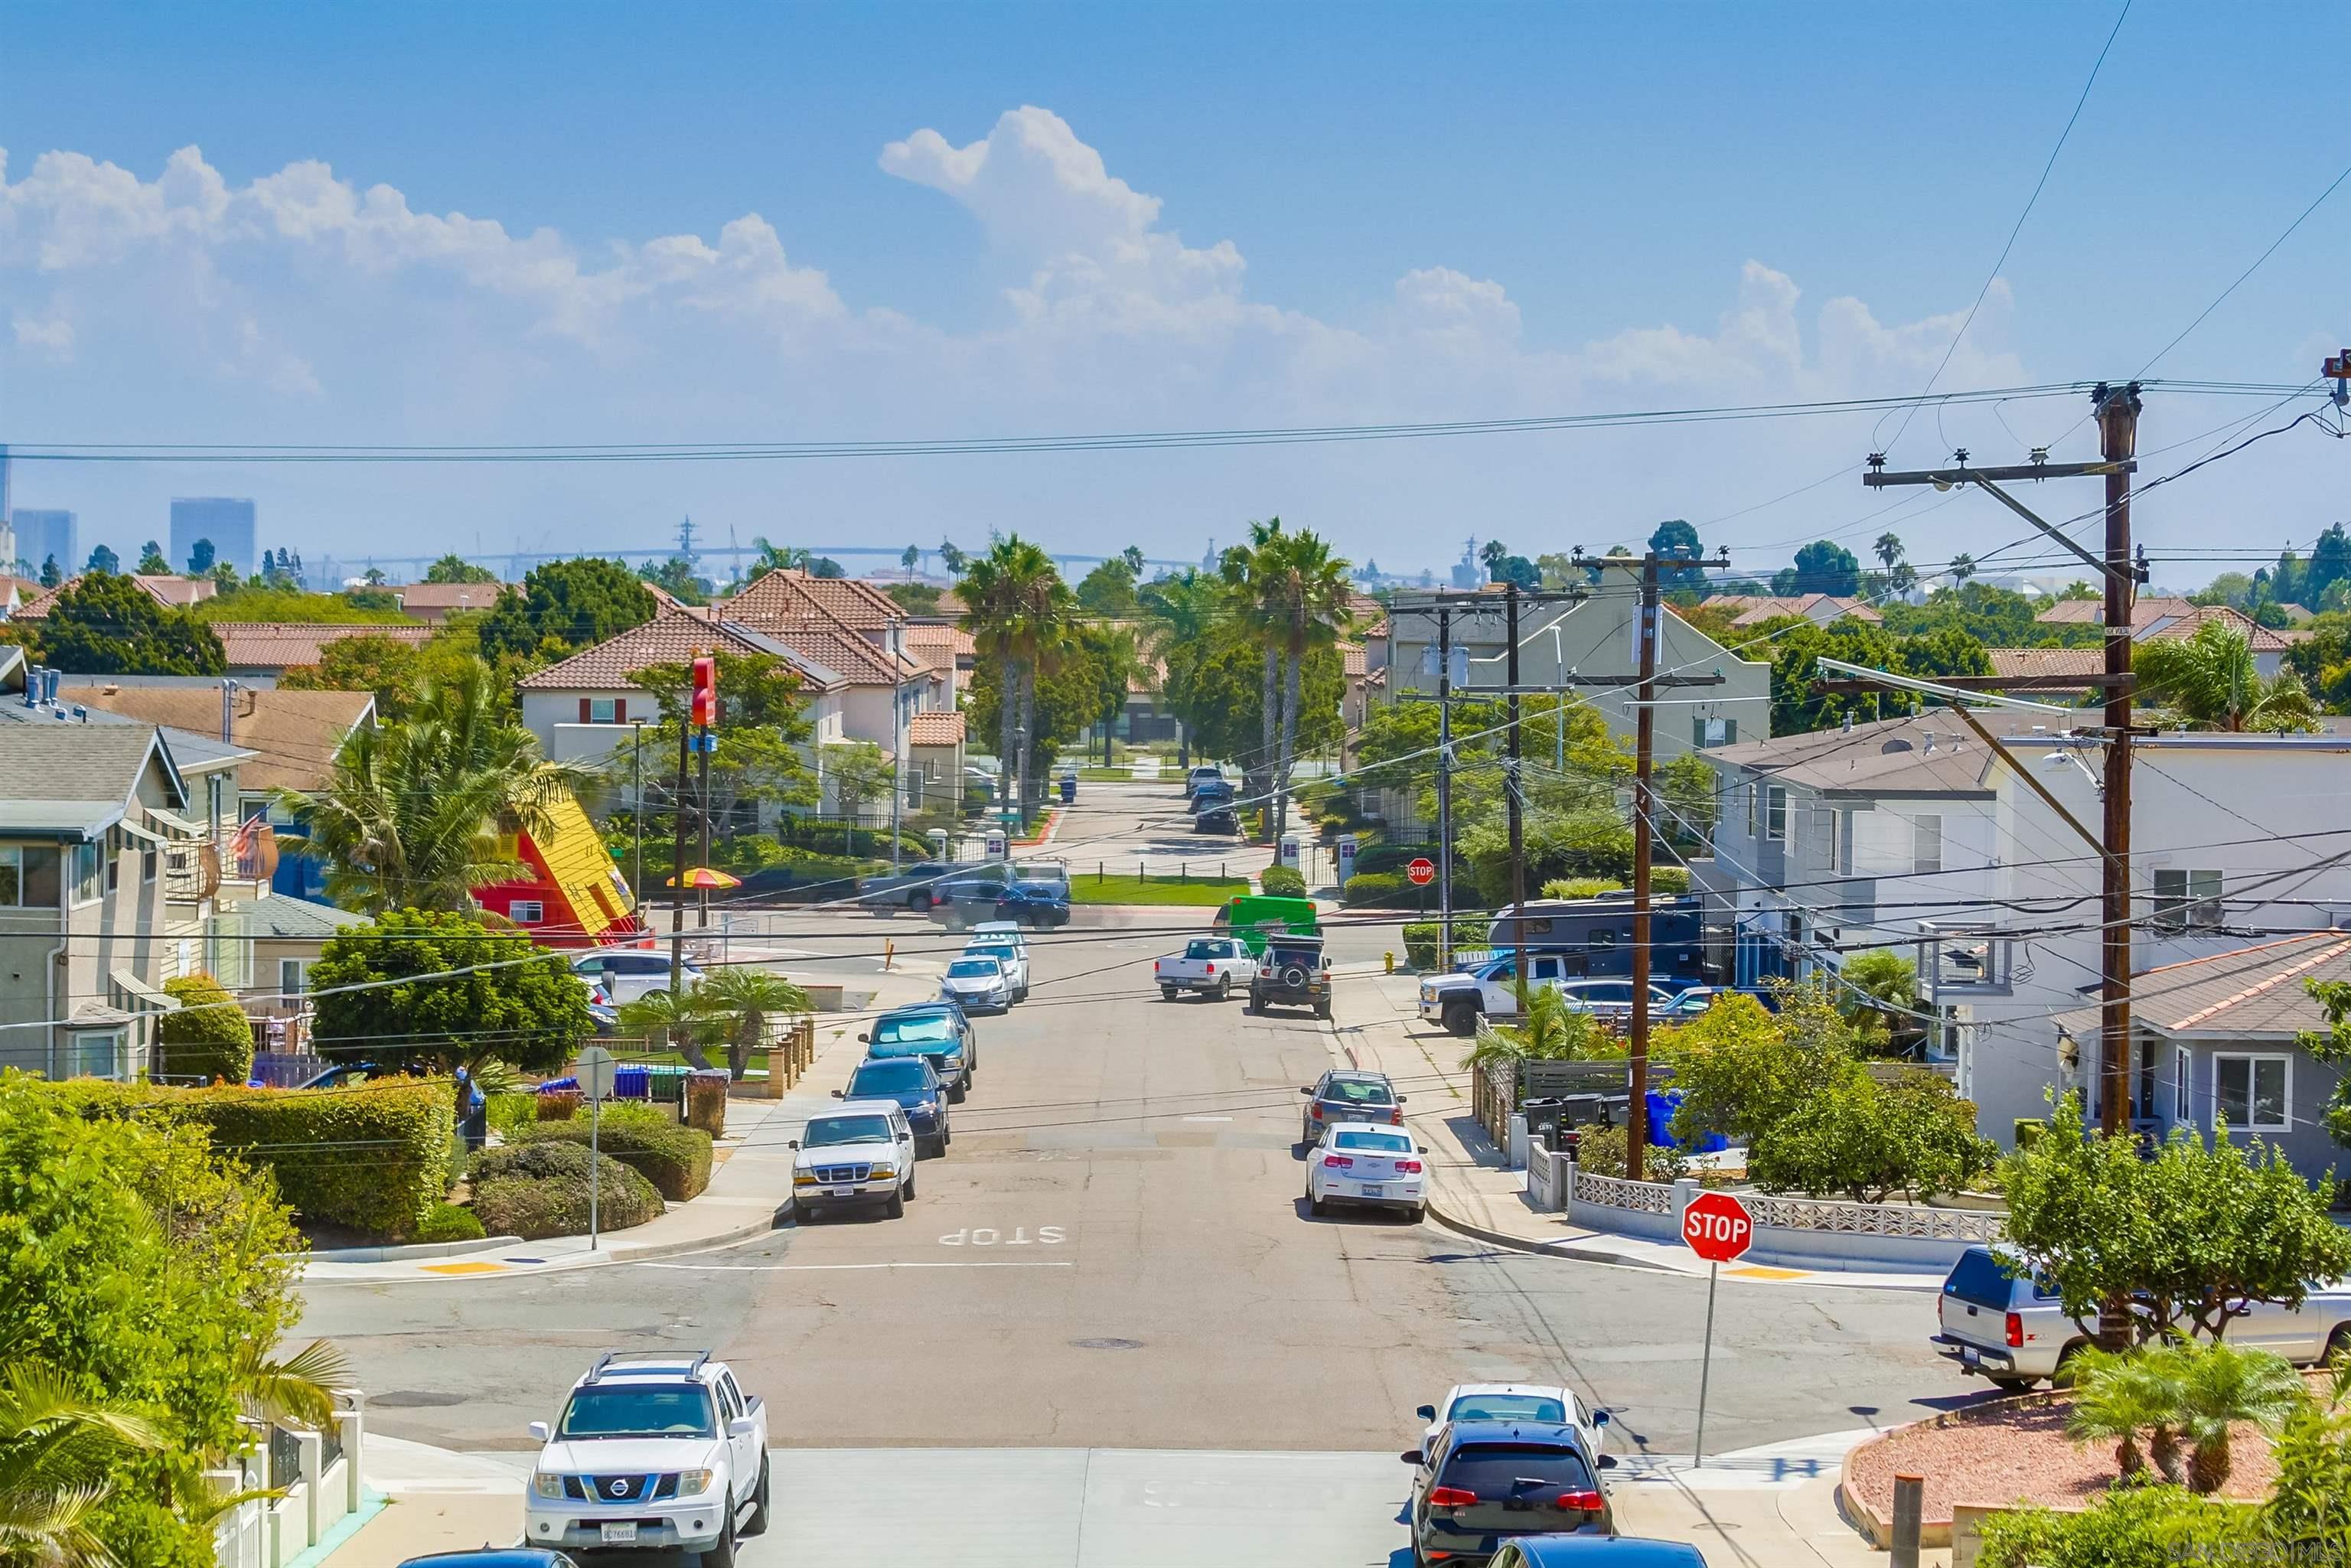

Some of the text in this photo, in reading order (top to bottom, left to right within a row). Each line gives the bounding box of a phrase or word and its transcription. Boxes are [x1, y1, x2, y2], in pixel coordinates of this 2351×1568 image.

[1410, 866, 1432, 876] STOP
[938, 1226, 1067, 1246] STOP
[1687, 1211, 1748, 1244] STOP
